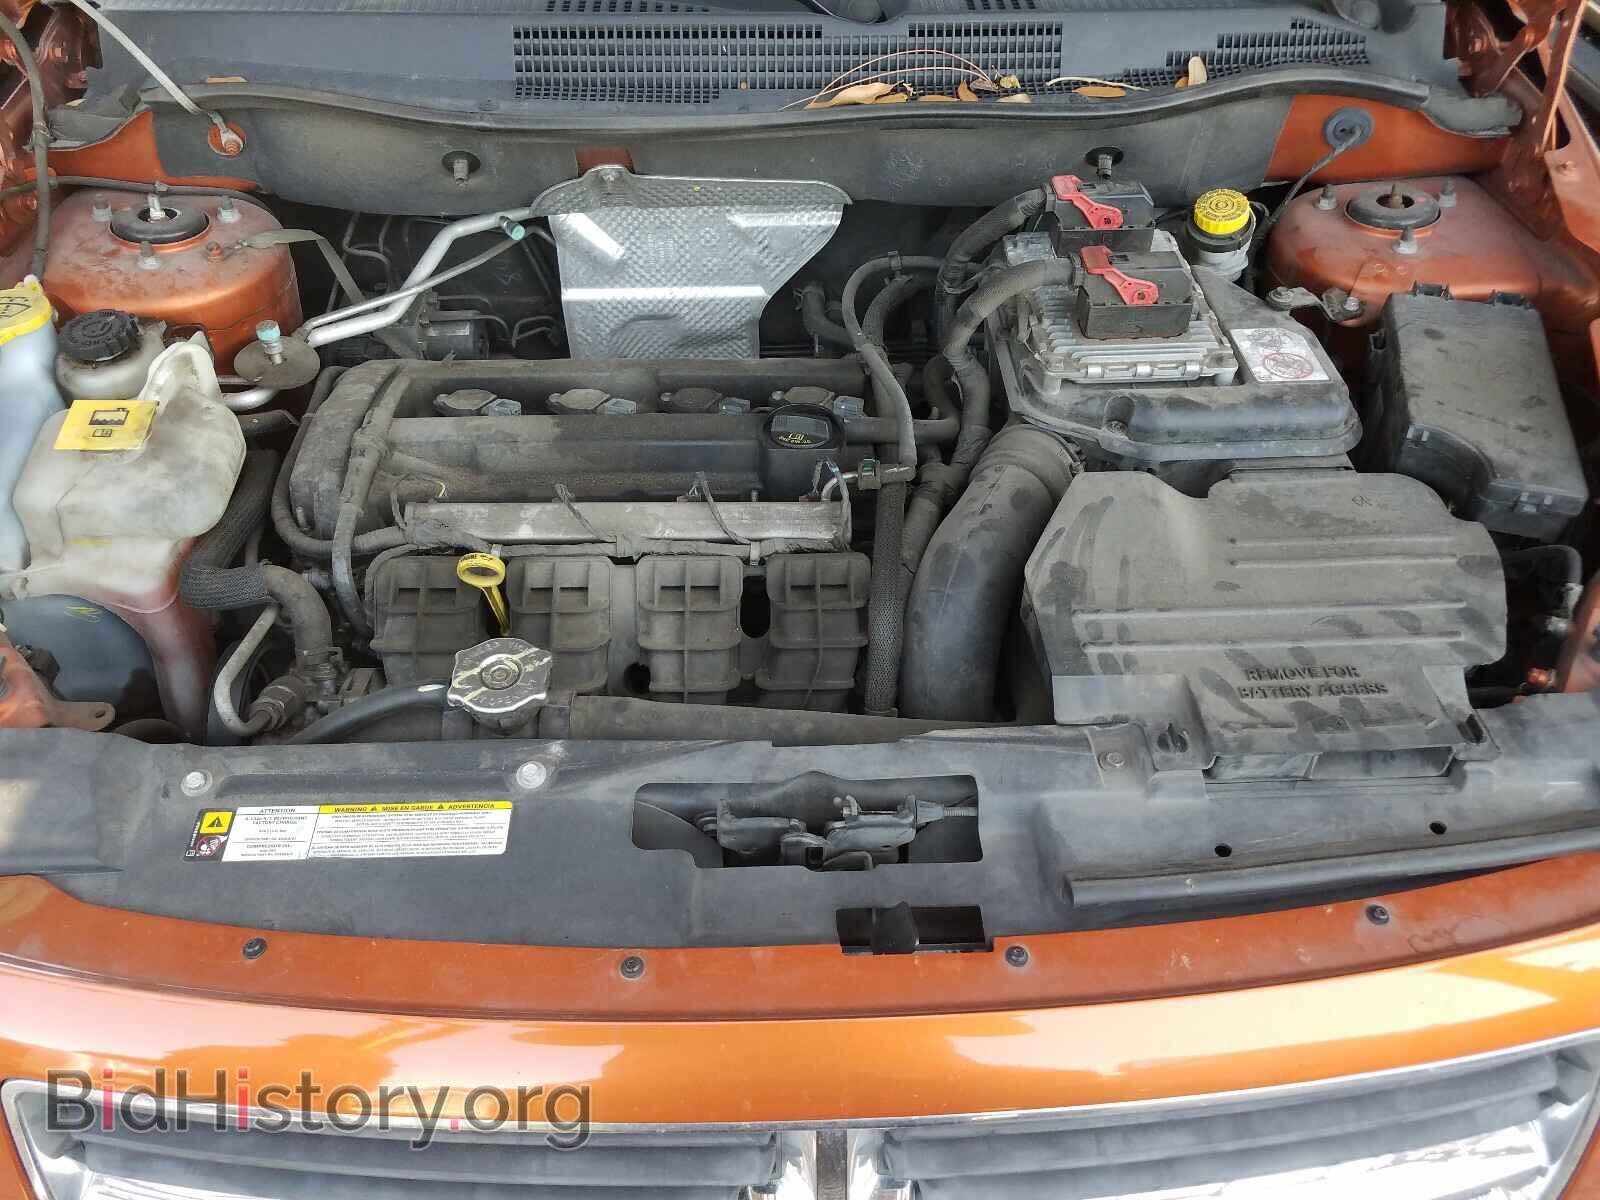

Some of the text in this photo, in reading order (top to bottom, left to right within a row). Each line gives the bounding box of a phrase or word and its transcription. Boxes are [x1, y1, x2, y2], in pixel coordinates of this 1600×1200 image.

[1244, 664, 1361, 681] REMOVE FOR
[1237, 680, 1389, 699] BATTERY ACCESS
[448, 802, 495, 810] ADVERTENCIA
